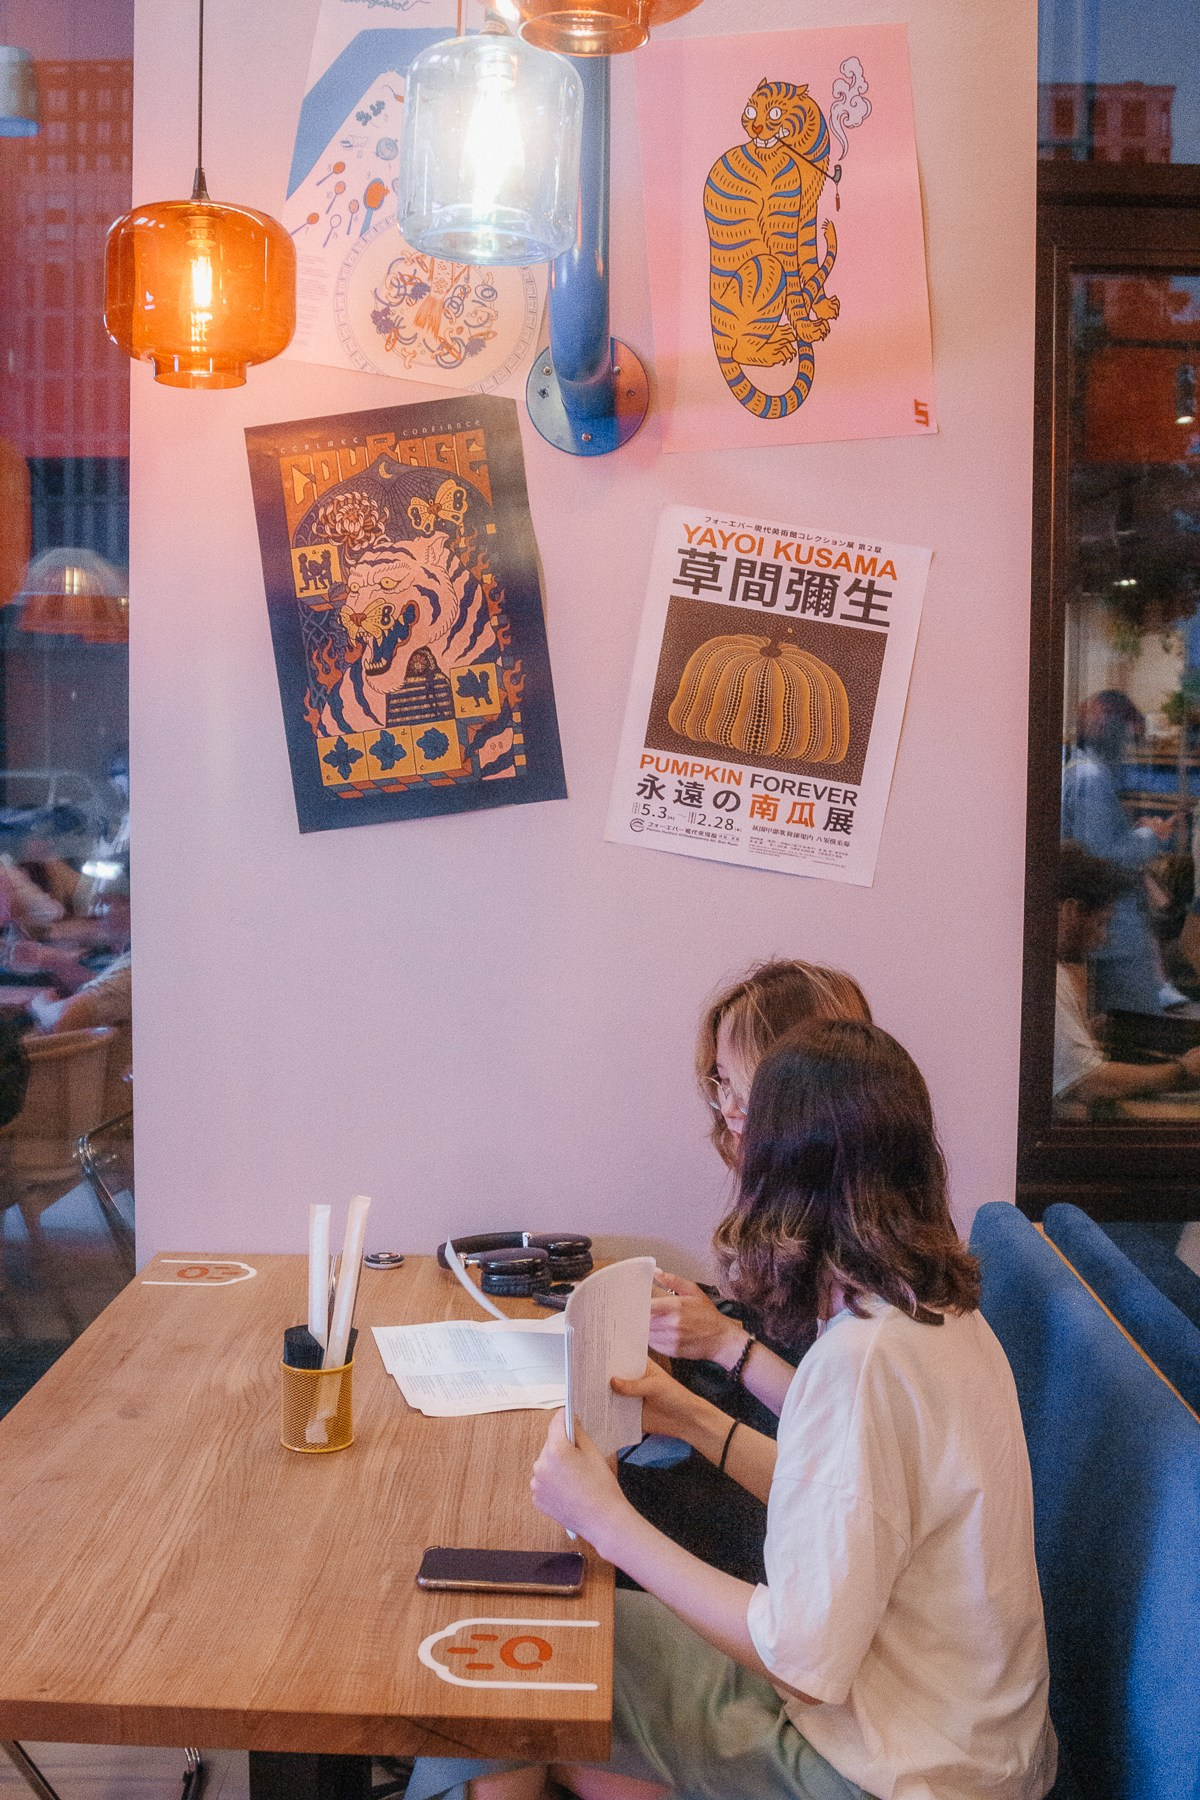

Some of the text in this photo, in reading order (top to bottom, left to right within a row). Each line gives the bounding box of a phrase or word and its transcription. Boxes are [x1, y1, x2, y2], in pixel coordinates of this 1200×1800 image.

[682, 523, 898, 581] YAYOI KUSAMA
[672, 547, 894, 628] 草間彌生
[639, 753, 859, 808] PUMPKIN FOREVER
[640, 803, 668, 819] 5.3
[696, 813, 735, 831] 2.28
